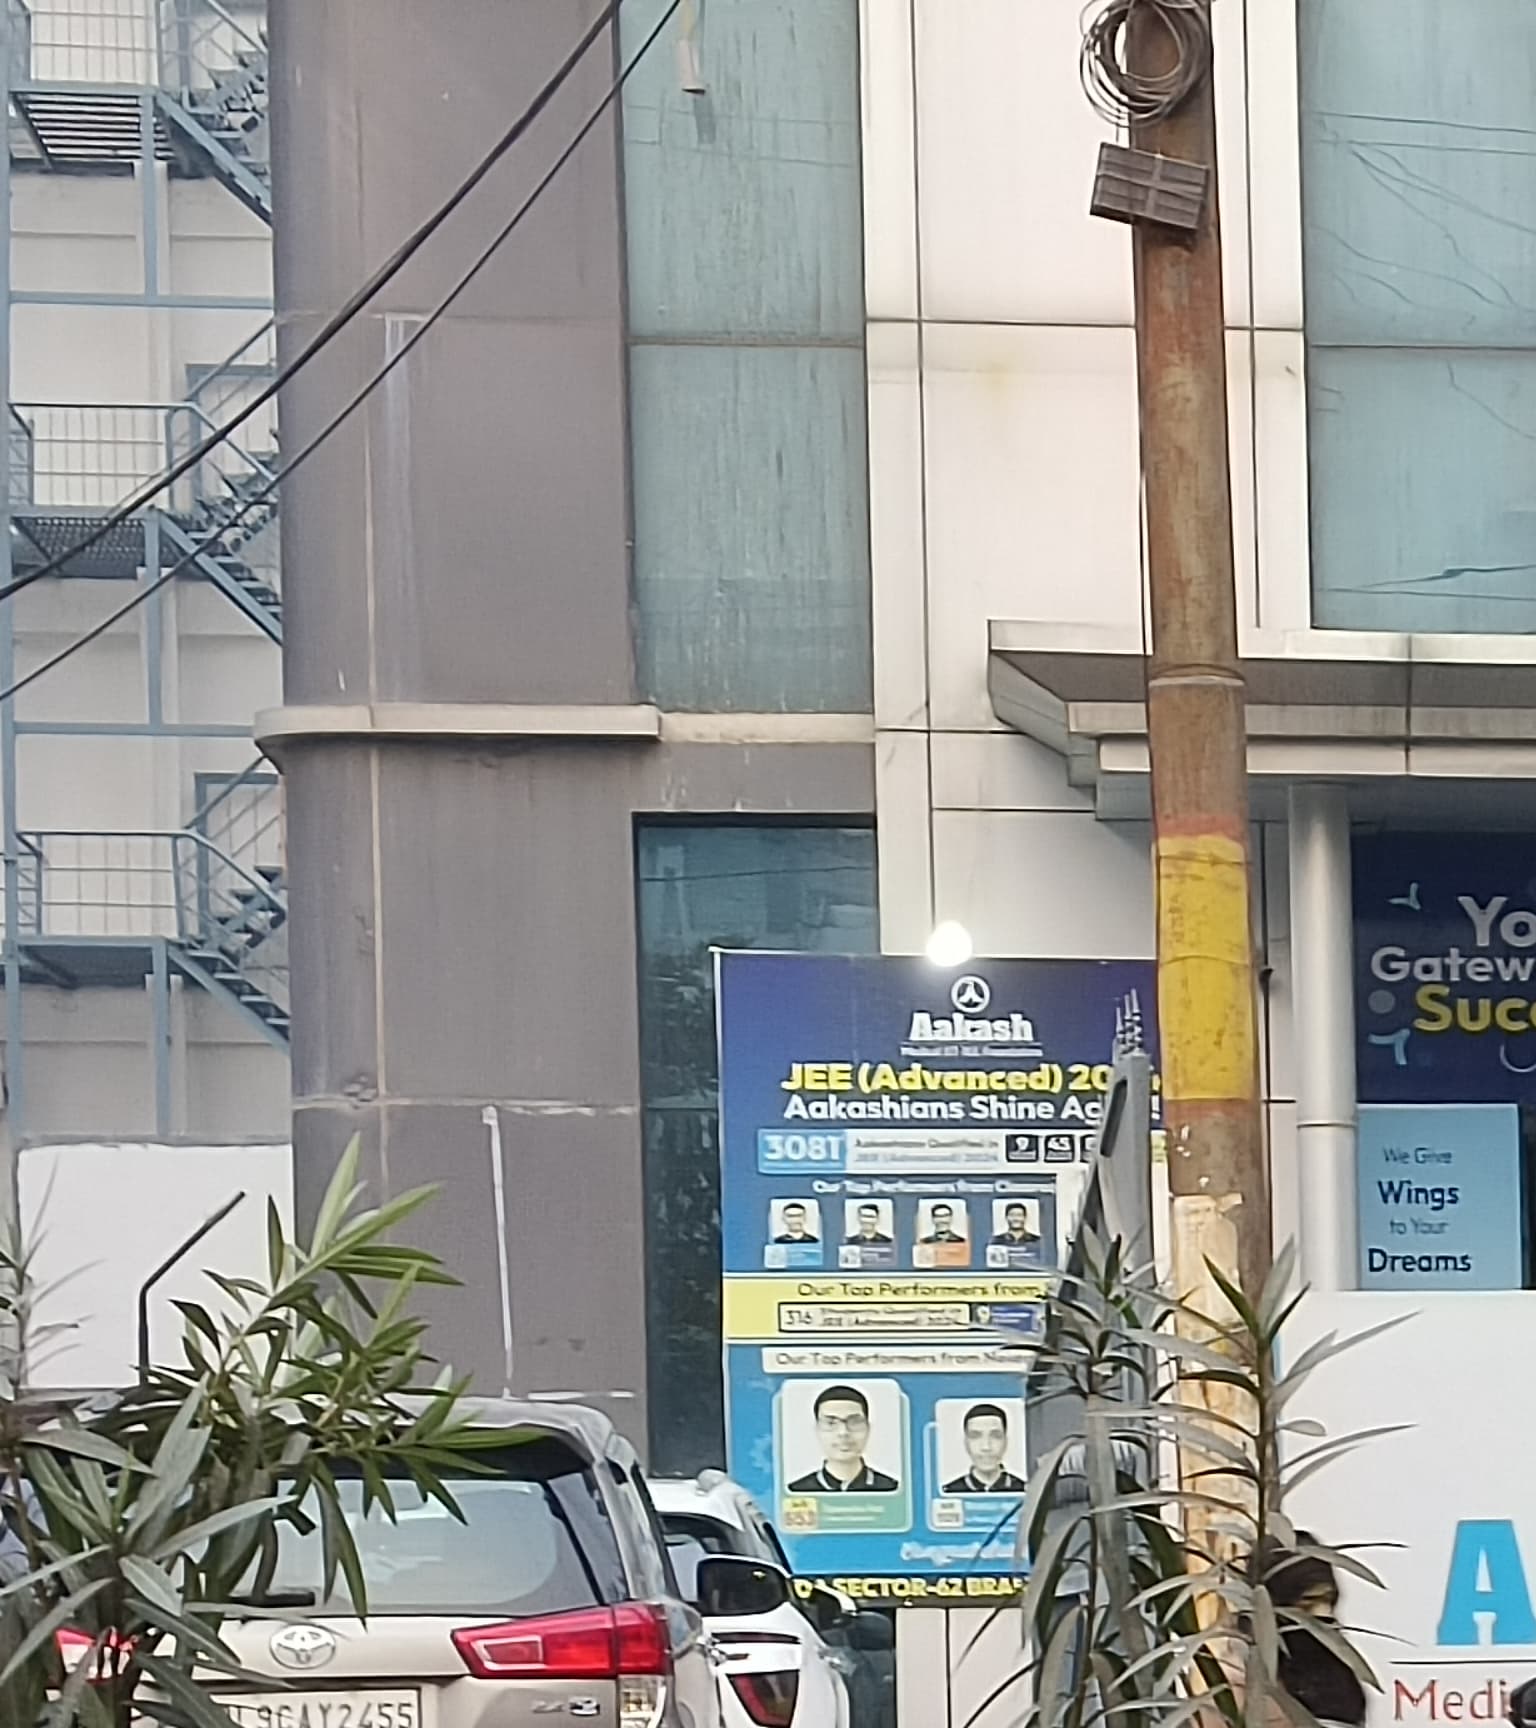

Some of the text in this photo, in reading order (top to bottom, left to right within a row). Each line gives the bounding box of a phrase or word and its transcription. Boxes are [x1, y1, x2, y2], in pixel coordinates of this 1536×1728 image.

[909, 1011, 1035, 1042] Aakash
[782, 1063, 853, 1092] JEE
[858, 1062, 1063, 1093] (Advanced)
[784, 1094, 963, 1122] Aakashians
[968, 1094, 1054, 1122] Shine
[1377, 1179, 1460, 1212] Wings
[1368, 1248, 1472, 1273] Dreams
[797, 1281, 1038, 1298] Our Top Performers from
